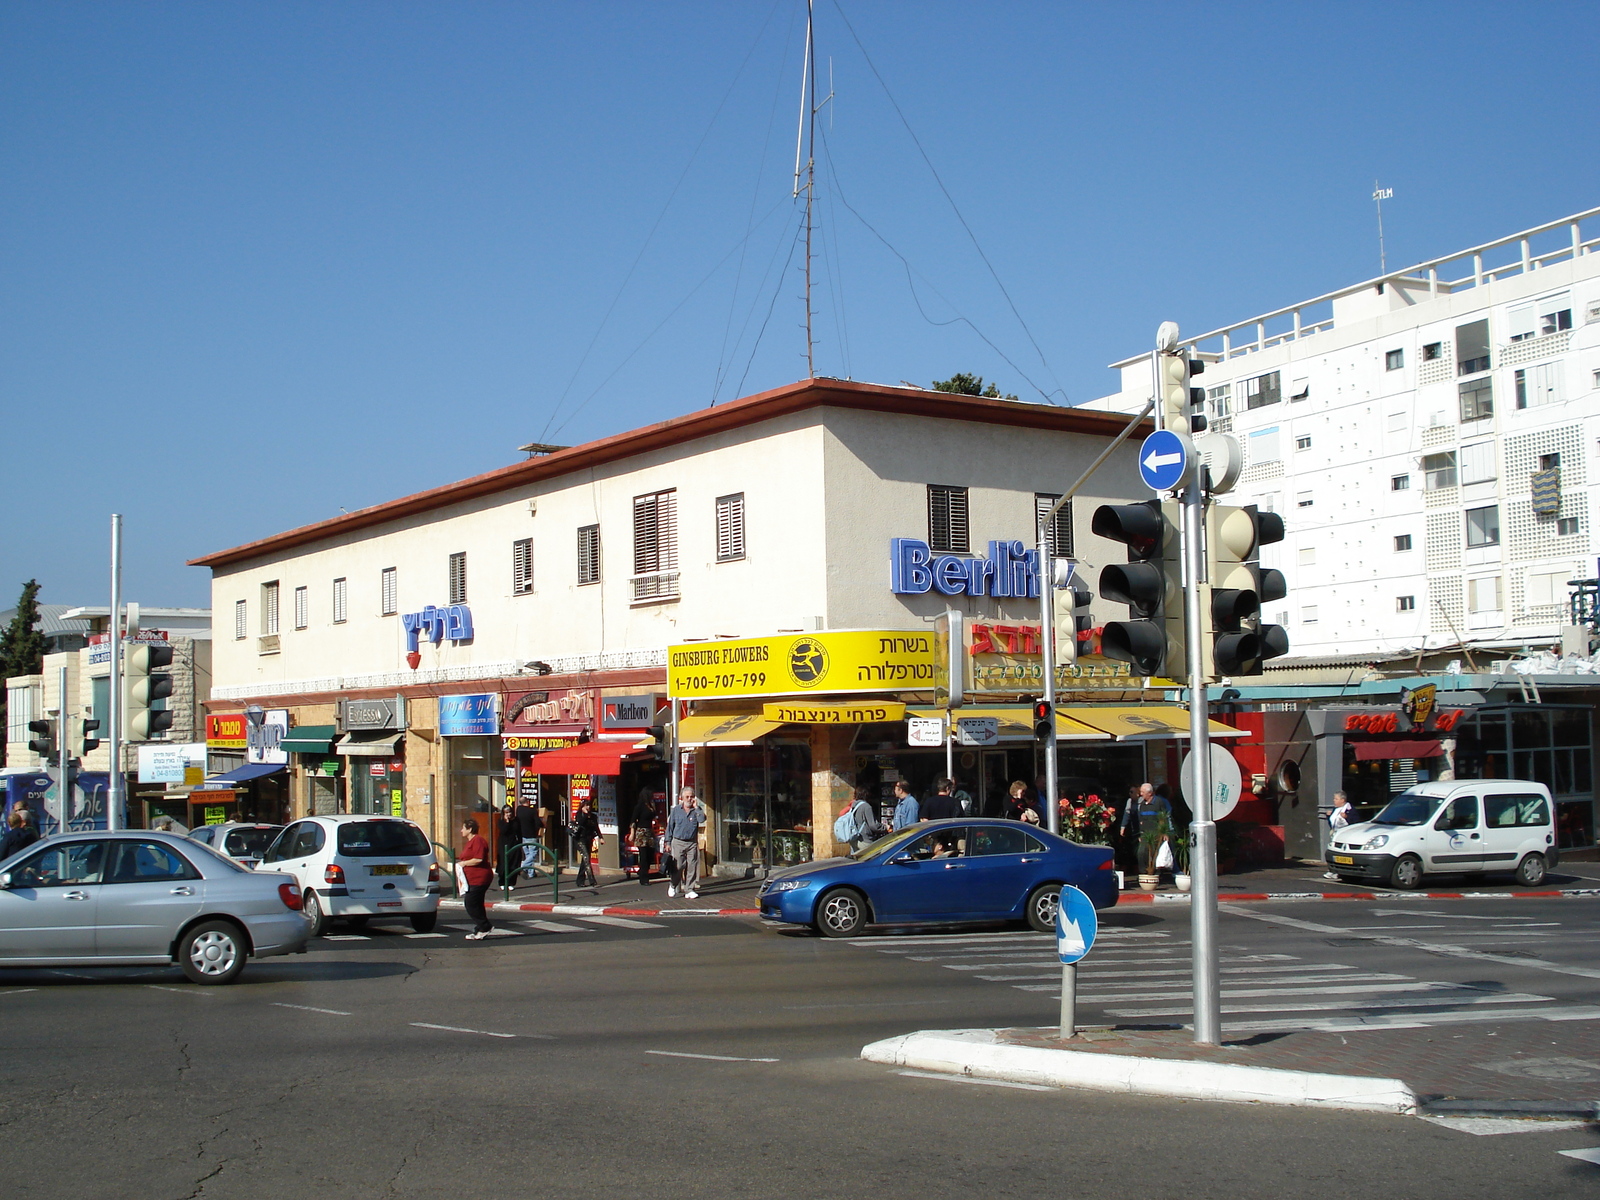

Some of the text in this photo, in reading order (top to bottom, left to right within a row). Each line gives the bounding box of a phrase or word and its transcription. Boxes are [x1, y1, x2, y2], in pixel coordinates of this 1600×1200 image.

[401, 605, 473, 652] ברליץ
[879, 638, 929, 654] בשרות
[673, 646, 769, 667] GINSBURG FLOWERS
[858, 661, 934, 681] נטרפלורה
[676, 672, 766, 690] 1-700-707-799
[617, 703, 649, 720] Marlboro
[778, 709, 887, 722] פרחי גינצבורג
[220, 721, 241, 735] טמבור
